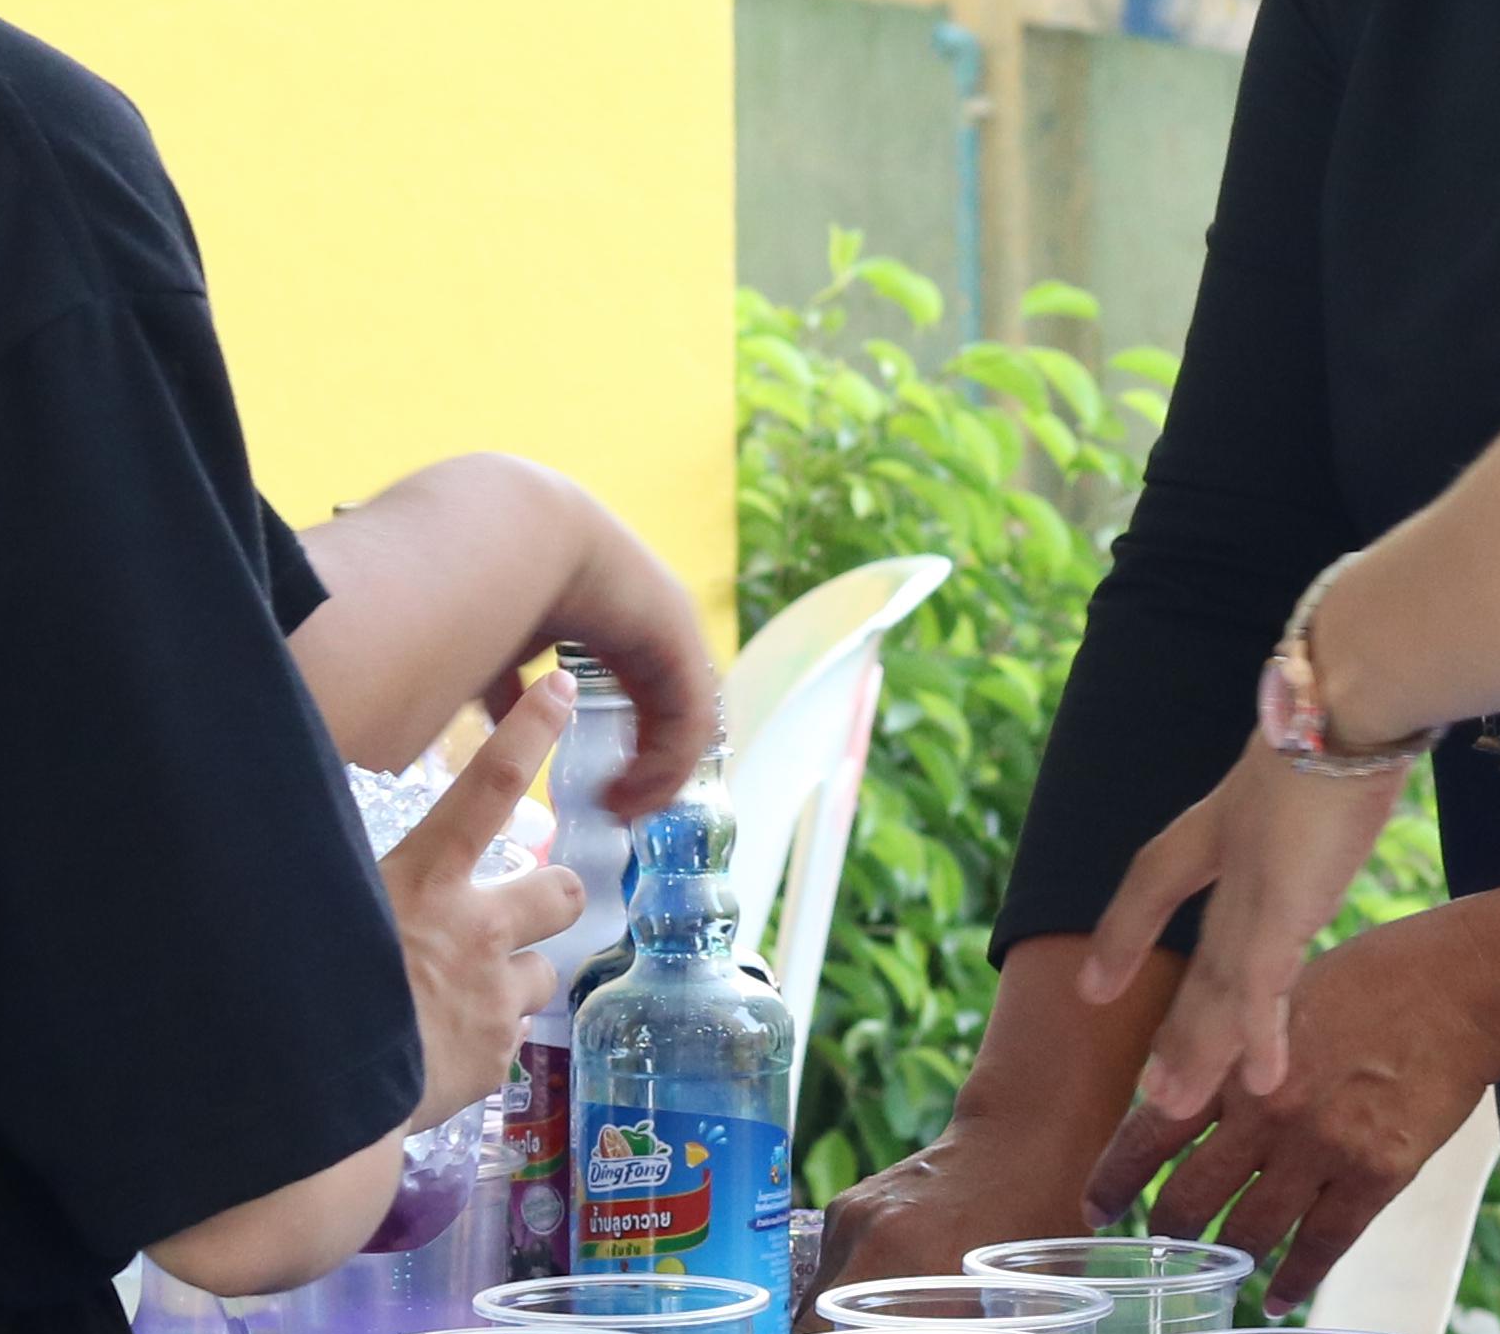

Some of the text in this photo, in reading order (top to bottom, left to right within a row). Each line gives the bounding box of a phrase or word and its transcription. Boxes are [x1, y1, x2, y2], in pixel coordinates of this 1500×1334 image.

[589, 1205, 672, 1238] น้ำบลูฮาวาย
